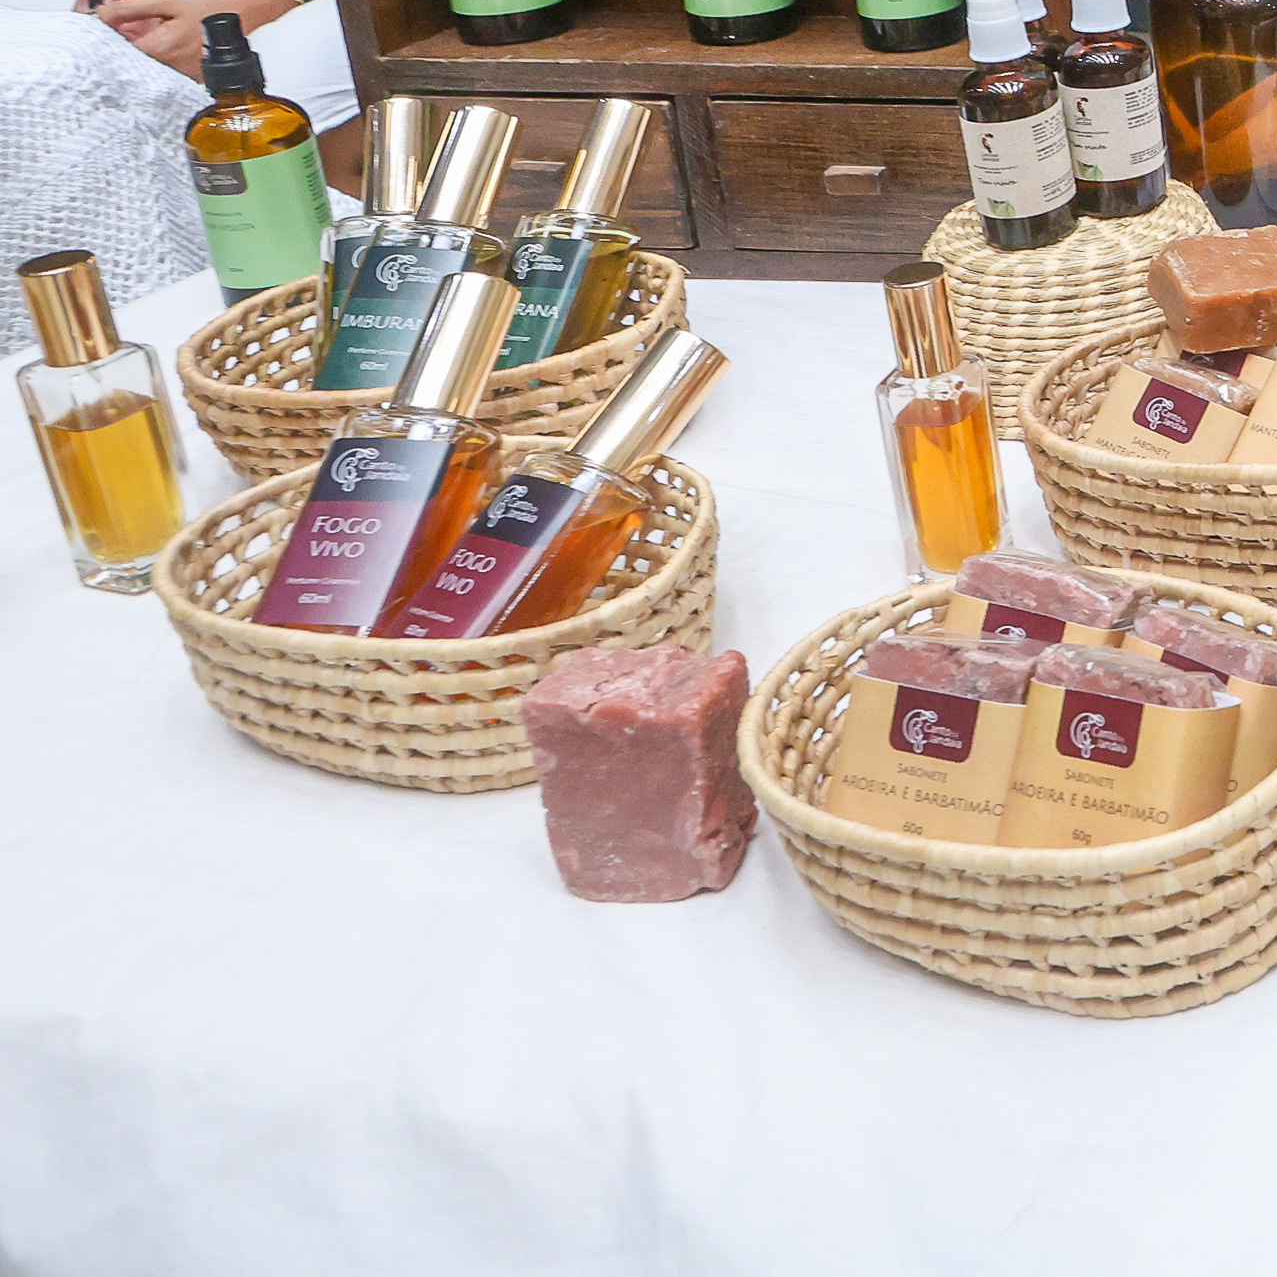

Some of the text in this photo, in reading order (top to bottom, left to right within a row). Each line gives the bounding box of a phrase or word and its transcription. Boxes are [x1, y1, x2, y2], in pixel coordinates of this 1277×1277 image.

[339, 313, 424, 331] IMBURAN
[1096, 437, 1148, 459] MANTEI
[1131, 436, 1171, 459] SABONETE
[311, 515, 383, 535] FOGO
[310, 540, 366, 559] VIVO
[448, 548, 497, 573] FOGO
[435, 572, 476, 596] VIVO
[896, 762, 948, 784] SABONETE
[1064, 768, 1116, 790] SABONETE
[842, 775, 1005, 817] AROEIRA E BARBATIMÃO
[1011, 780, 1170, 824] AROEIRA E BARBATIMÃO
[1071, 828, 1093, 846] 60g
